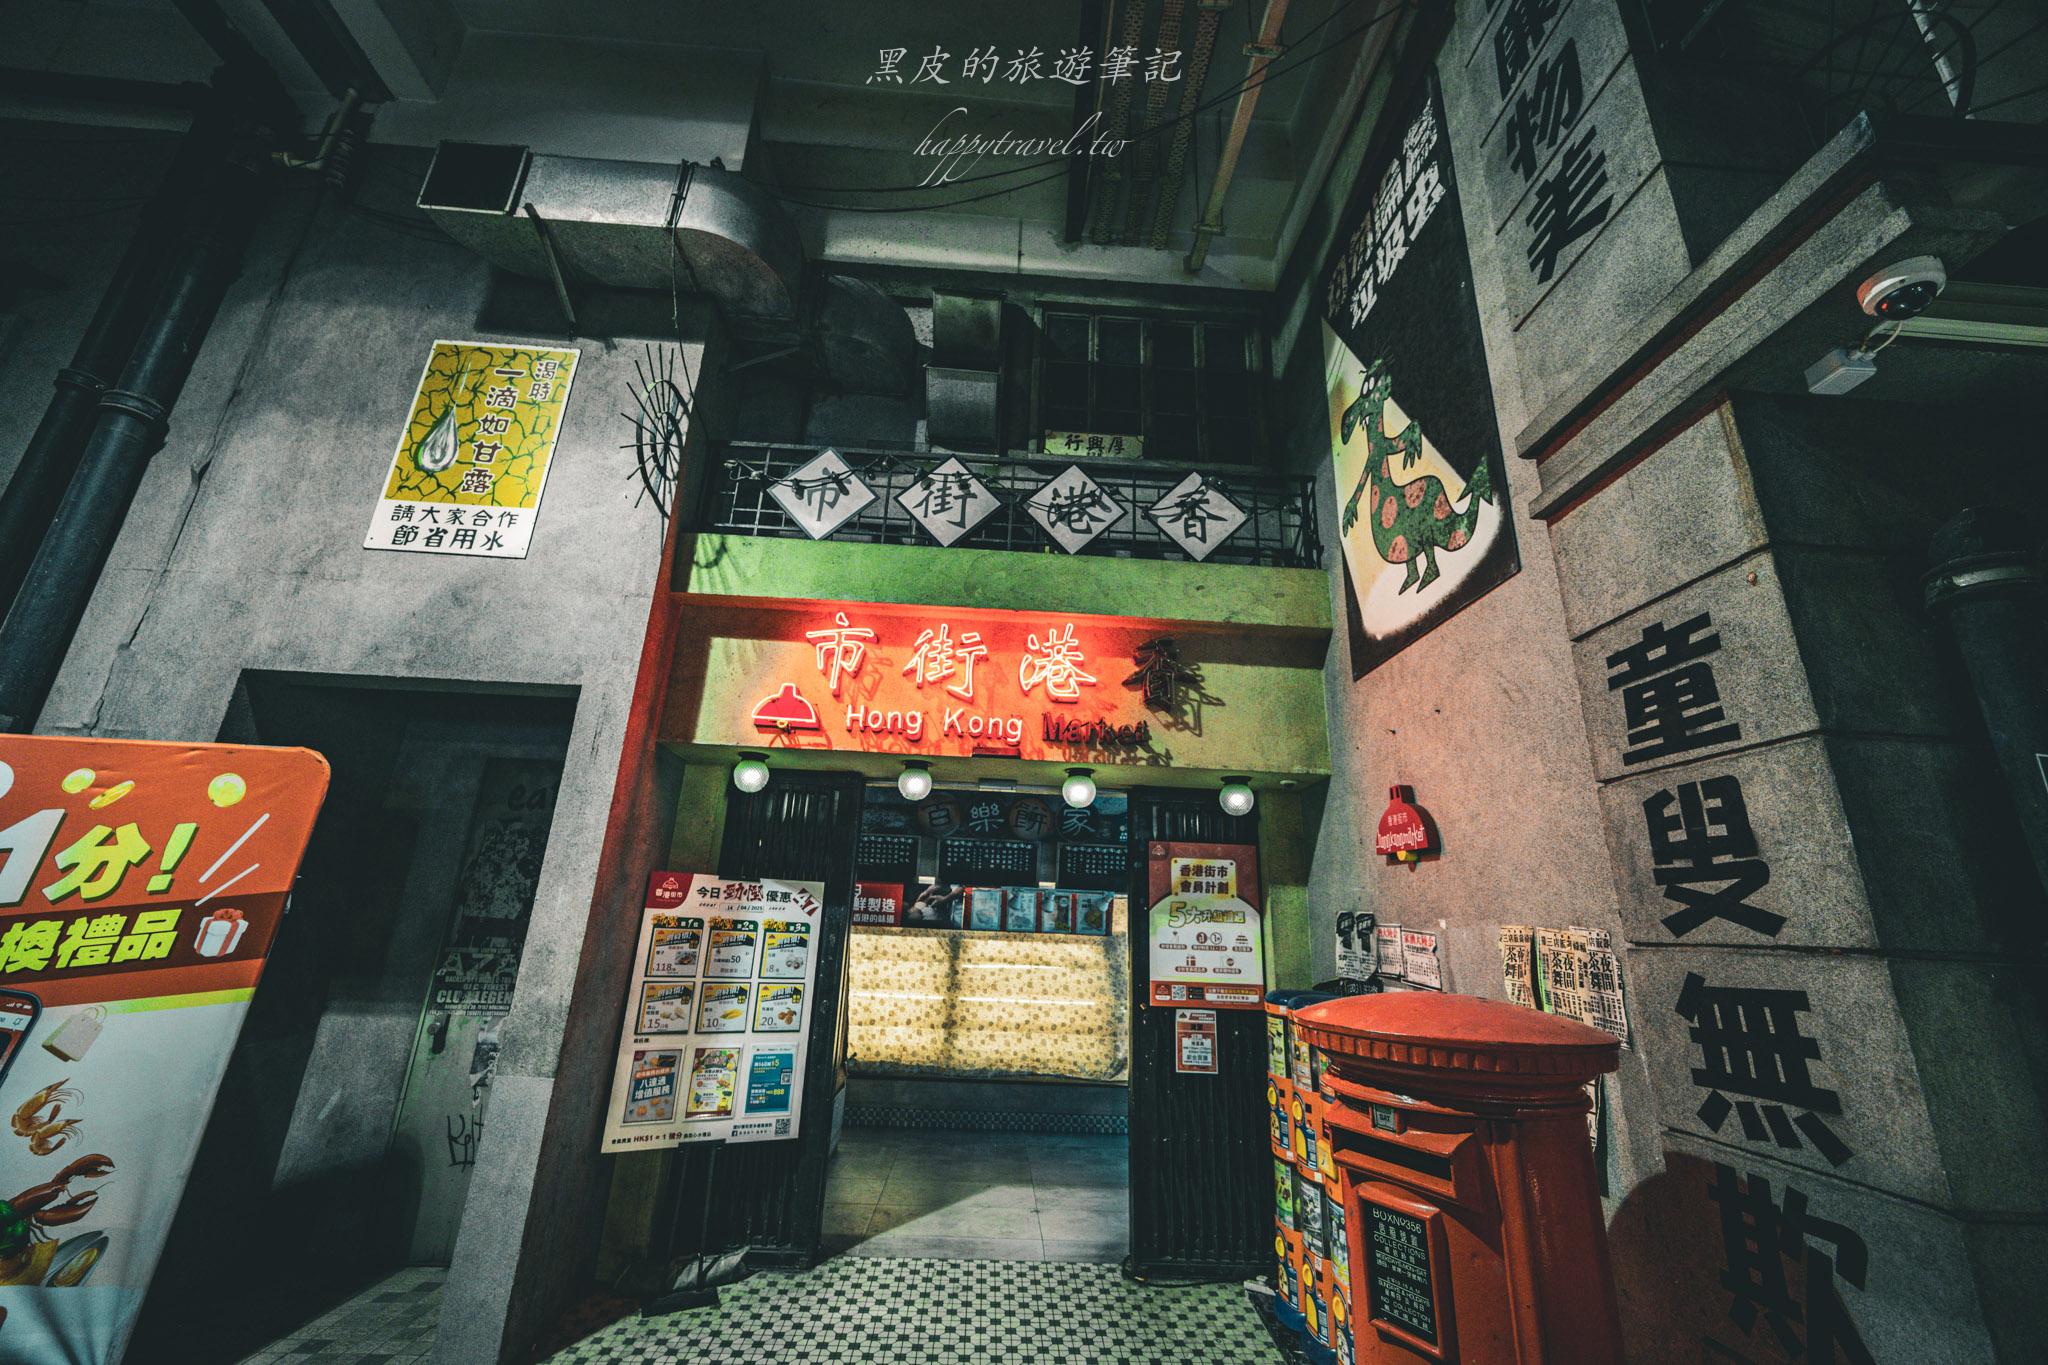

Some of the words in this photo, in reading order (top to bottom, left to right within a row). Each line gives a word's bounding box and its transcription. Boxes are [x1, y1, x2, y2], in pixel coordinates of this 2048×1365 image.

[1486, 0, 1614, 285] 廉物美
[528, 360, 558, 401] 渴時
[460, 366, 525, 495] 一滴如甘露
[391, 504, 519, 528] 請大家合作
[391, 524, 504, 551] 節省用水
[846, 704, 923, 736] Hong
[943, 707, 1023, 743] Kong
[1042, 711, 1151, 746] Market
[1180, 865, 1228, 878] 香港街市
[0, 908, 182, 973] 換禮品
[1606, 611, 1876, 1365] 童叟無欺
[1373, 1233, 1426, 1261] COLLECTIONS
